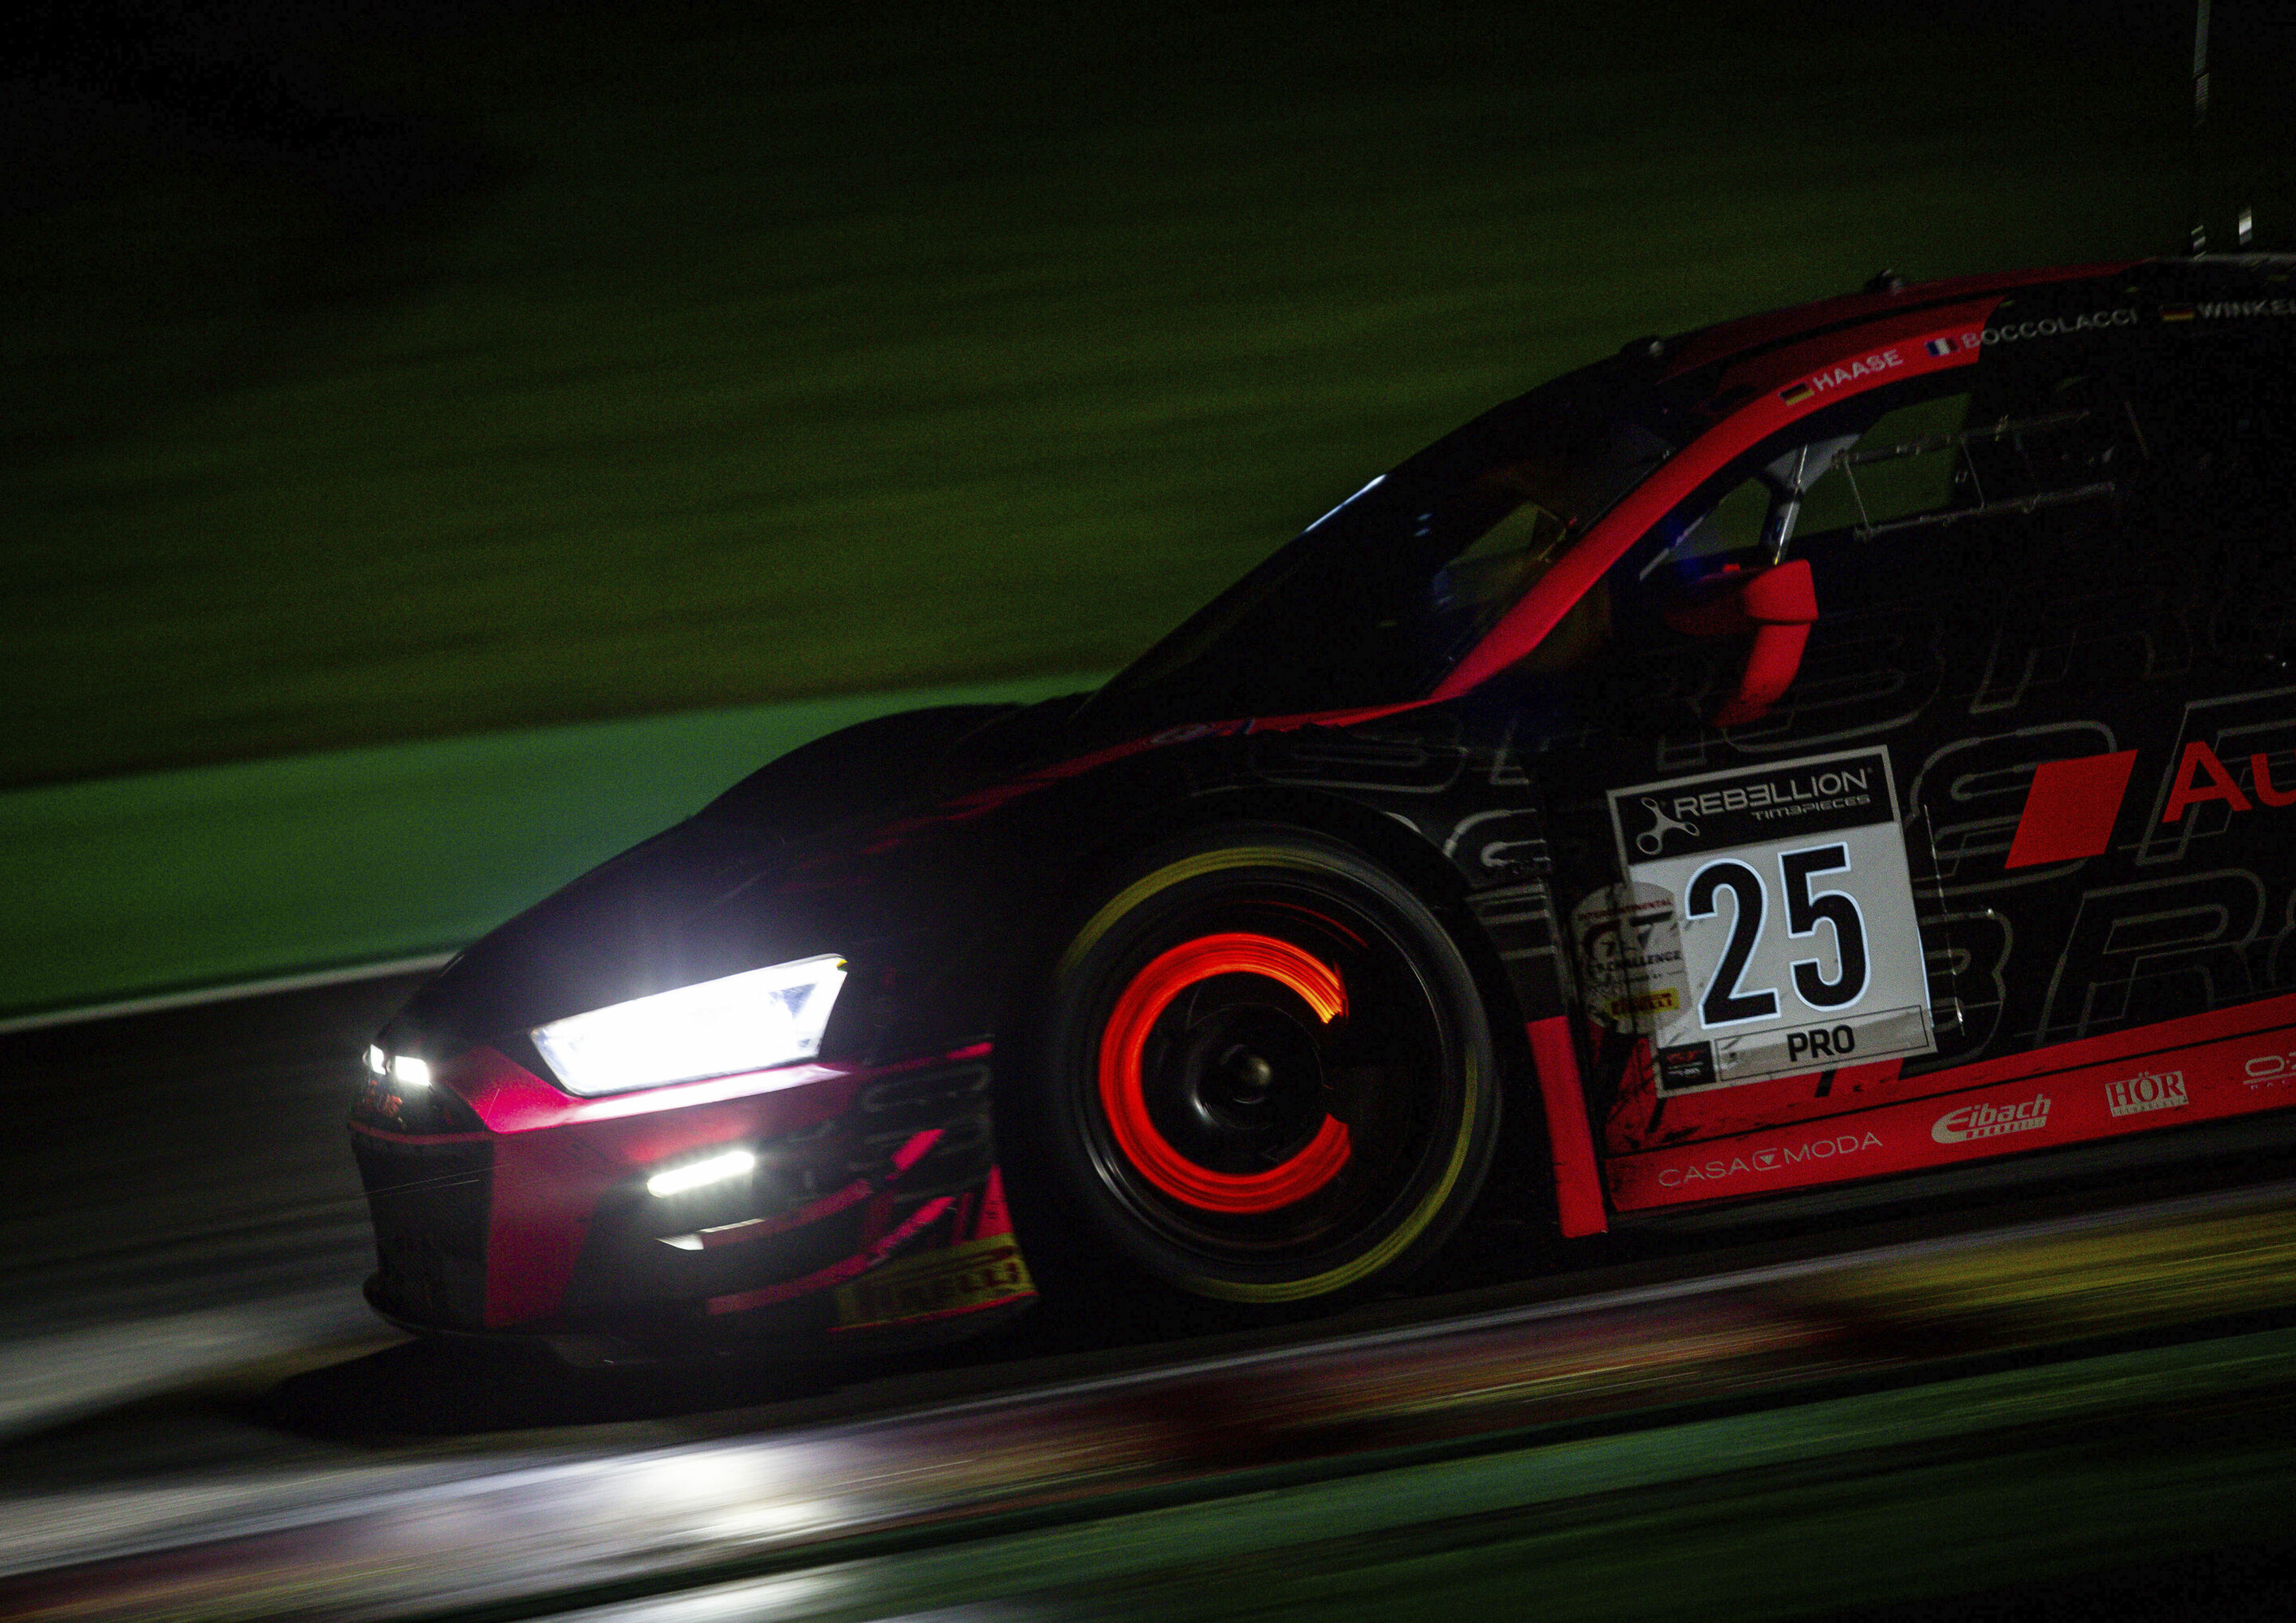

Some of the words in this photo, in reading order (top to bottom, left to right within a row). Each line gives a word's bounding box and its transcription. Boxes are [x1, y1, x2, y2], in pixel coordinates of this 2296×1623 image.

[1964, 308, 2139, 349] BOCCOLACCI
[1812, 348, 1905, 391] HAASE
[1674, 768, 1869, 820] REBELLION
[1685, 842, 1871, 1030] 25
[1787, 1024, 1855, 1062] PRO
[2109, 1071, 2183, 1107] HÖR
[1931, 1093, 2052, 1144] Eibach
